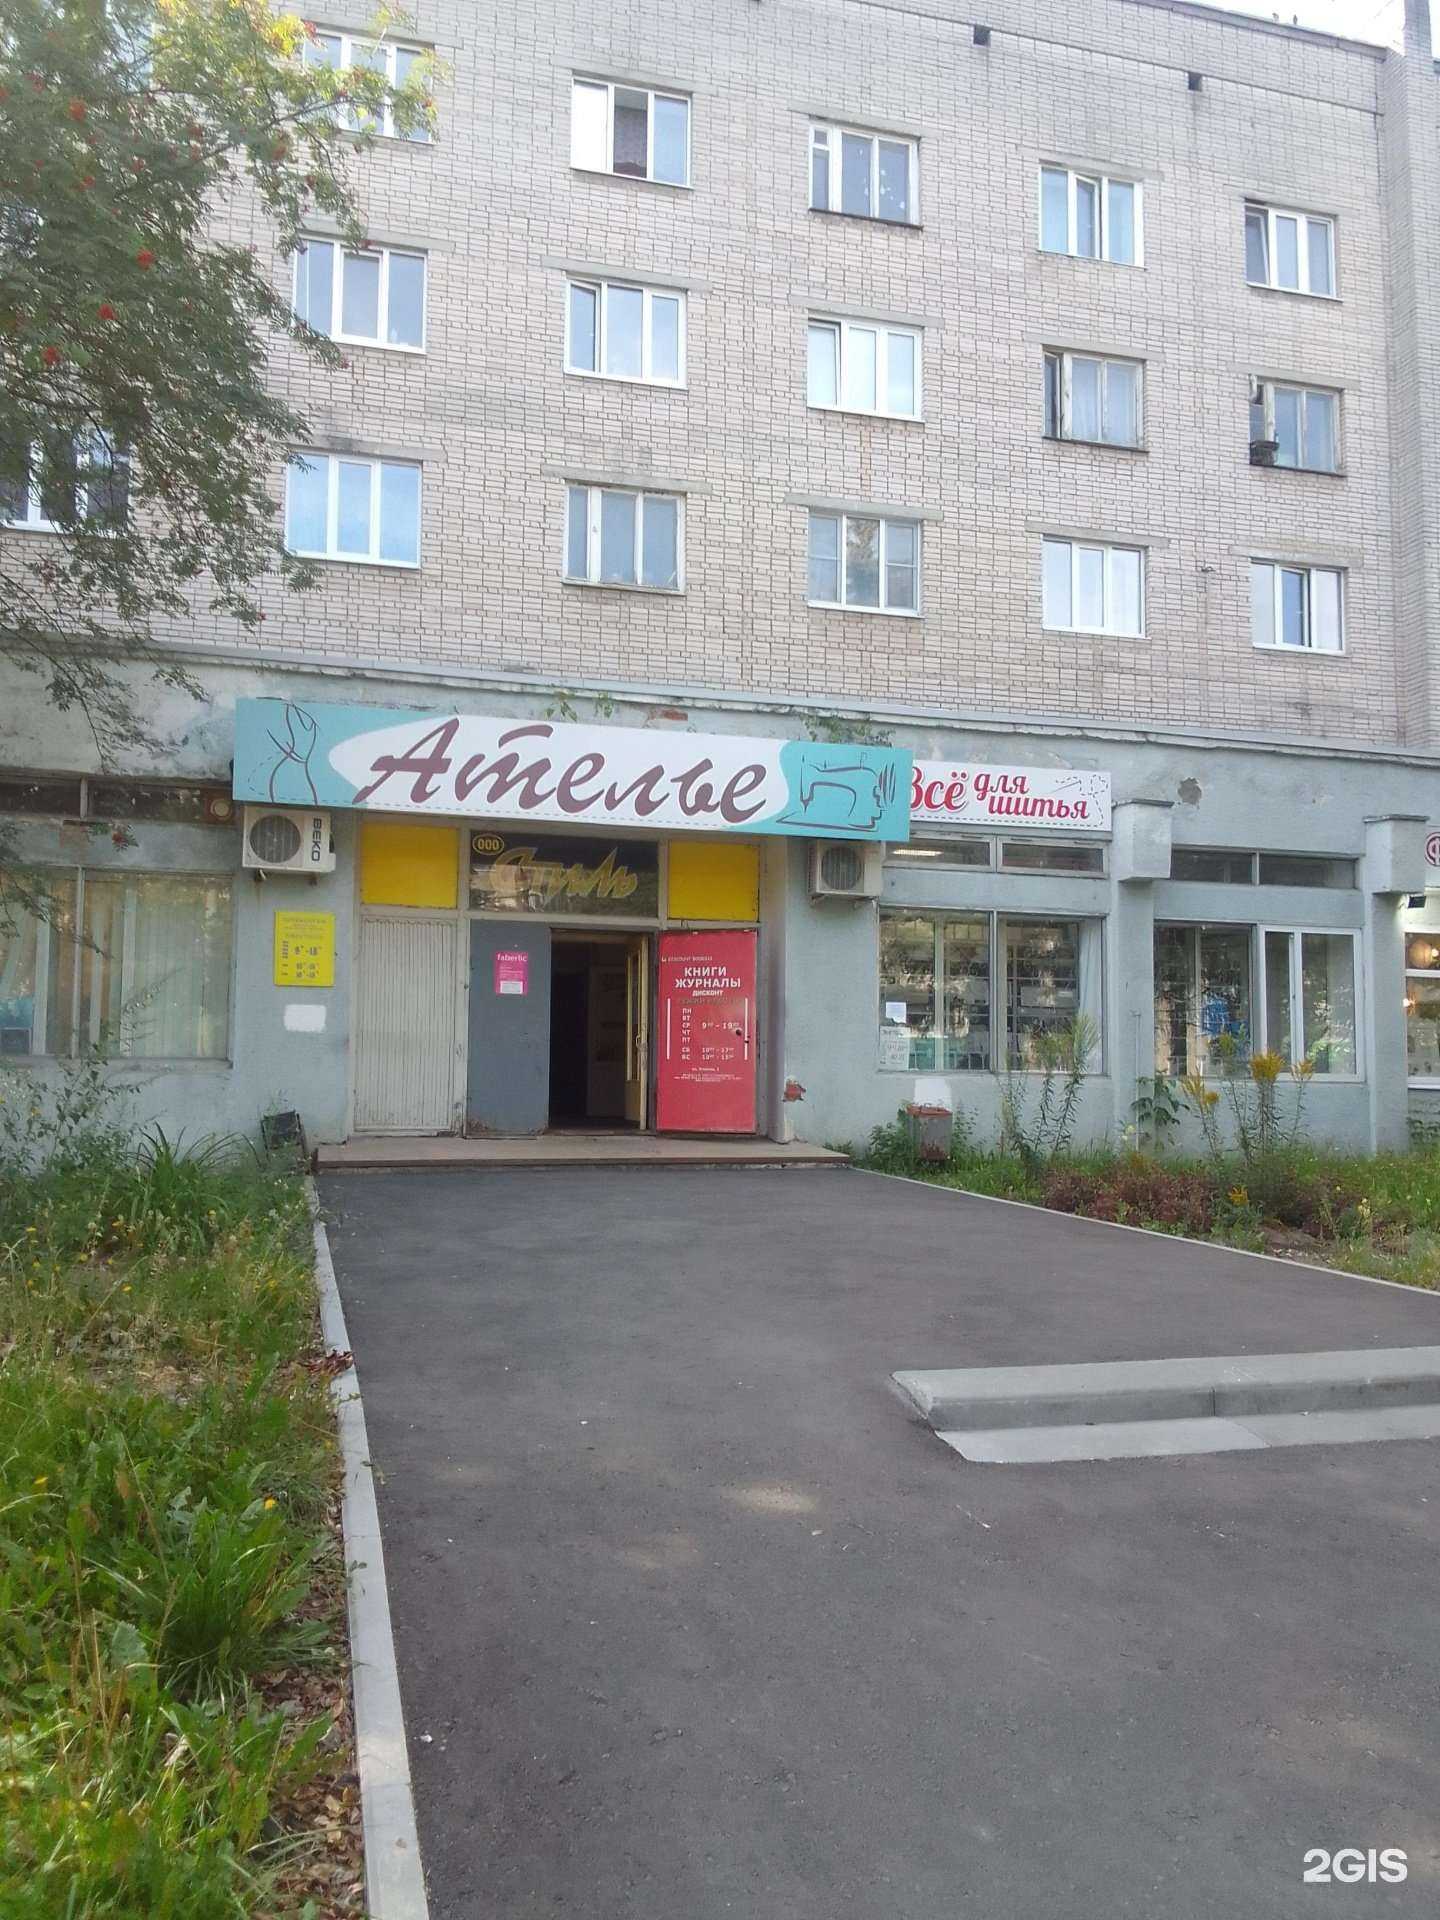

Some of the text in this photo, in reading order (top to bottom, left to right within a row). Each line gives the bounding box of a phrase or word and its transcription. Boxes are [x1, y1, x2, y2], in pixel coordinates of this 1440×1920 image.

[353, 716, 767, 823] Ателье
[973, 773, 1029, 801] для
[988, 795, 1091, 820] шитья
[311, 817, 322, 862] BEKO
[675, 978, 741, 988] ЖУРНАЛЫ
[684, 966, 727, 977] КНИГИ
